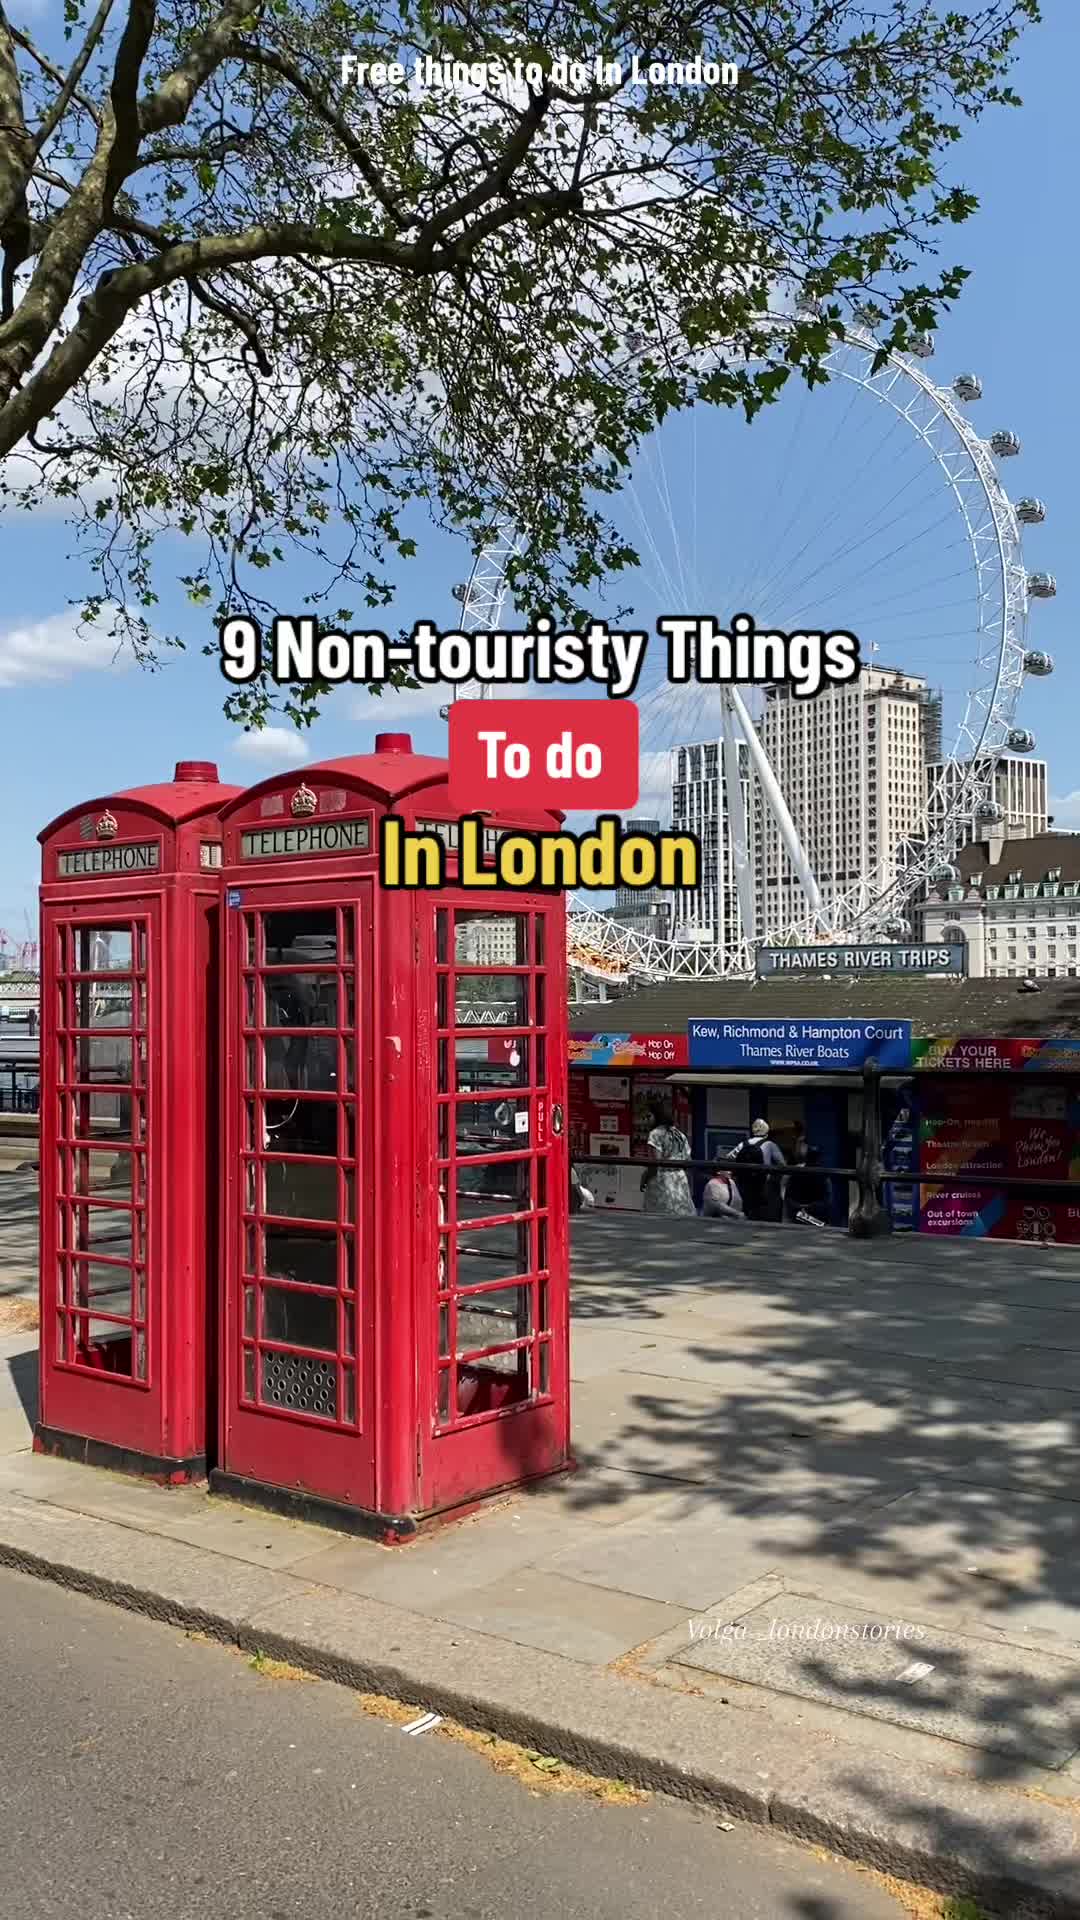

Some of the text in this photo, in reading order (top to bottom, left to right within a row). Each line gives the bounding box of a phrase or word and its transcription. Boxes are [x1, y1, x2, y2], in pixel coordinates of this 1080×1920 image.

[247, 822, 366, 855] TELEPHONE
[63, 845, 157, 873] TELEPHONE
[769, 949, 950, 968] THAMES RIVER TRIPS
[692, 1025, 904, 1042] Kew, Richmond & Hampton Court
[648, 1040, 662, 1049] Hop
[663, 1040, 674, 1049] On
[739, 1043, 850, 1058] Thames River Boats
[928, 1045, 998, 1057] BUY YOUR
[648, 1051, 675, 1060] Hop Off
[916, 1056, 970, 1069] TICKETS
[975, 1057, 1011, 1069] HERE
[537, 1101, 545, 1142] PULL
[927, 1209, 943, 1219] Out
[945, 1209, 955, 1219] of
